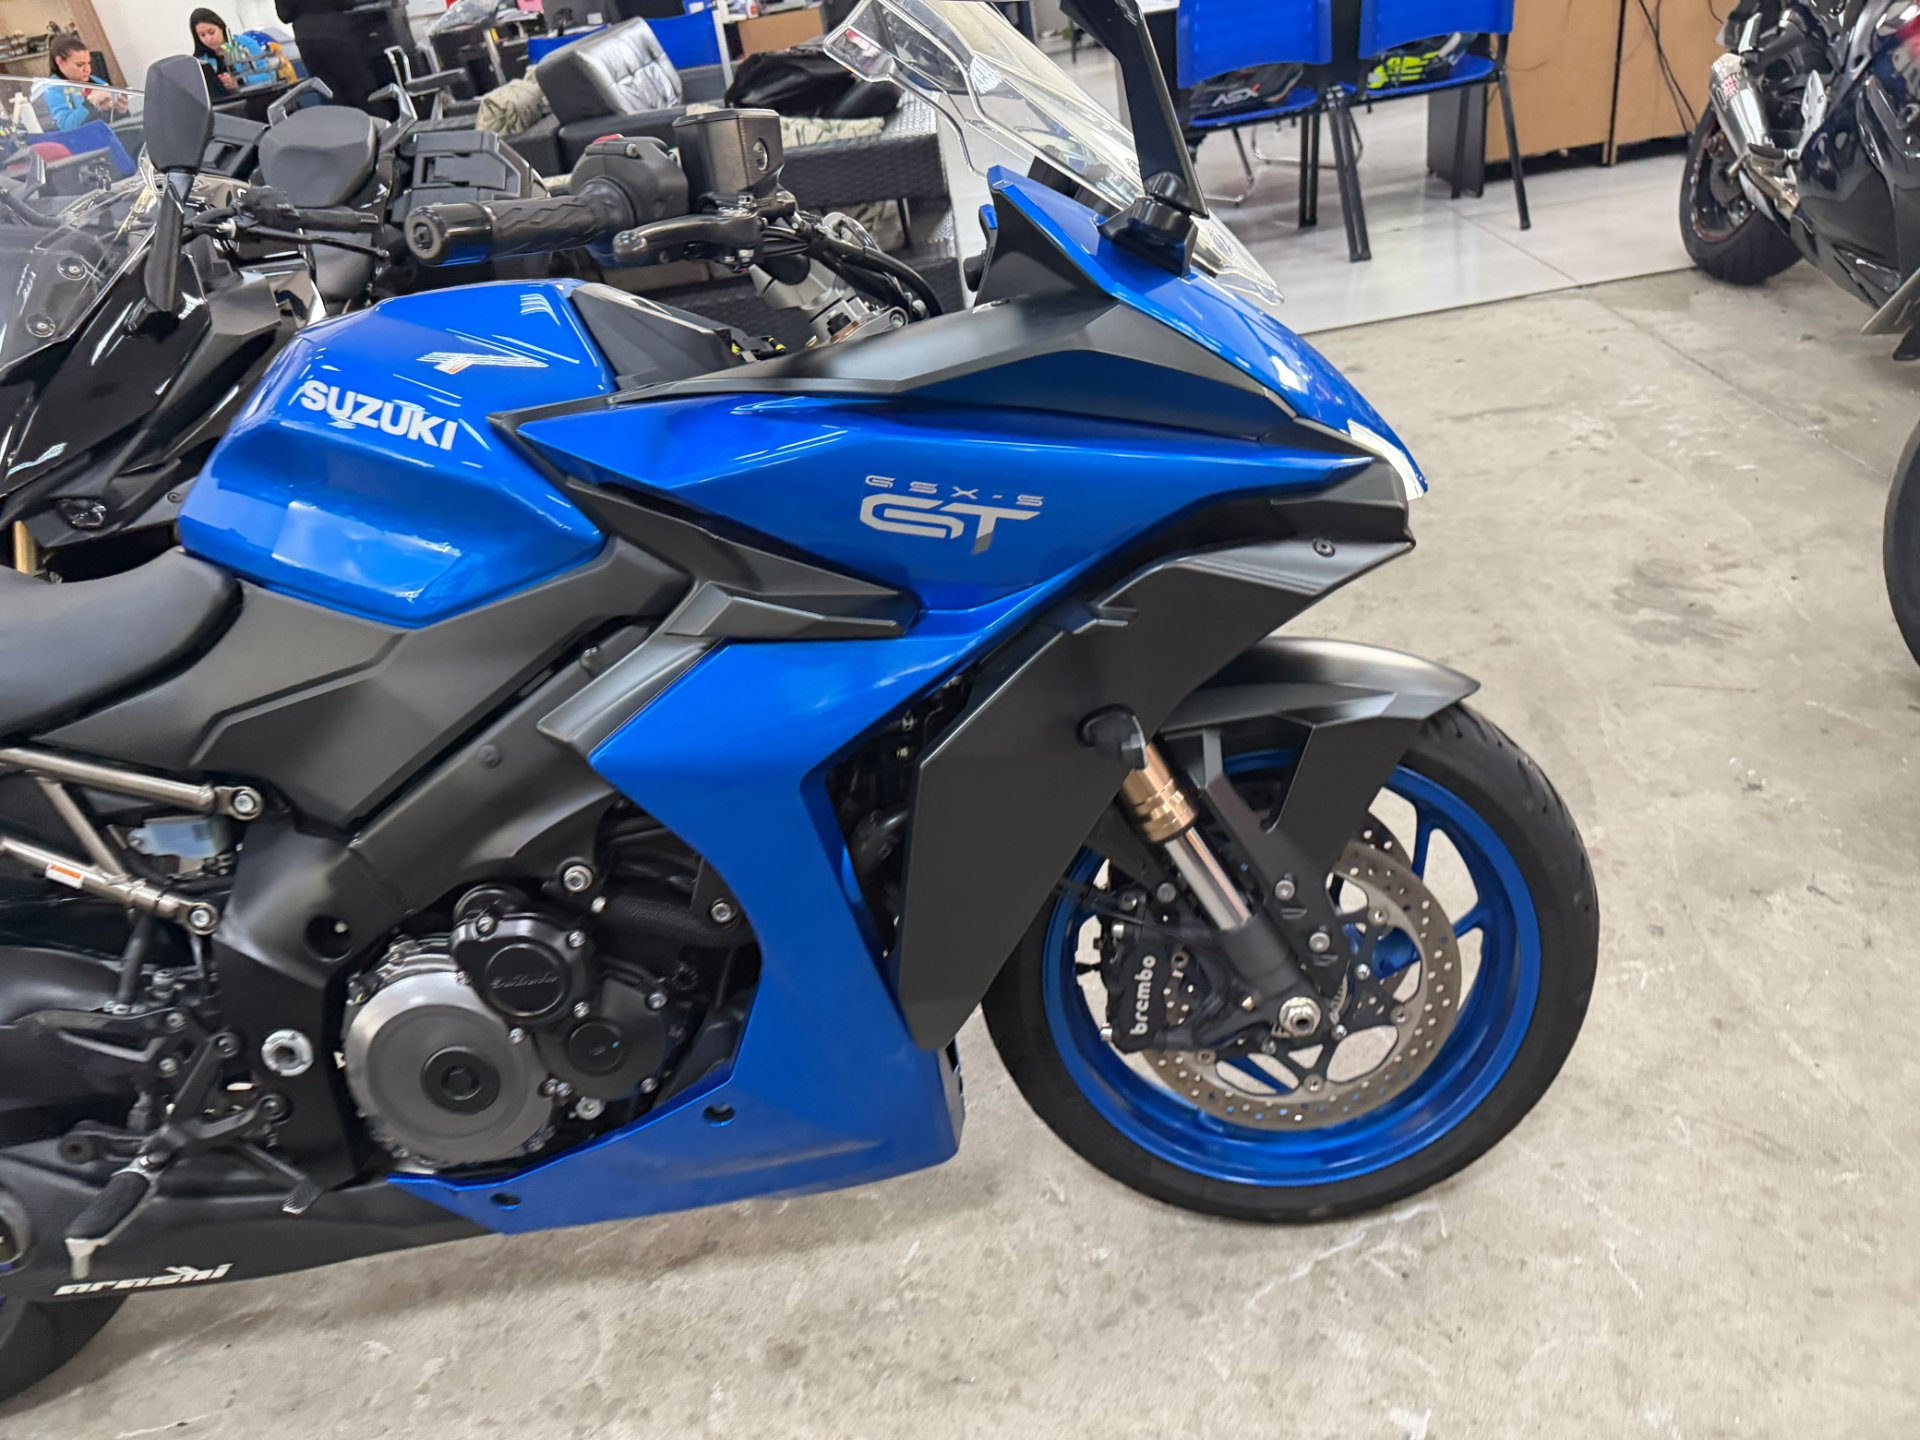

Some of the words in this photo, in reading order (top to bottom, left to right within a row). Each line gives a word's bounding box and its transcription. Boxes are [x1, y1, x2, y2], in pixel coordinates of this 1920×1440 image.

[300, 380, 458, 451] SUZUKI
[859, 493, 1041, 556] GT
[865, 475, 1044, 507] GSX-S
[1129, 955, 1156, 1035] brembo
